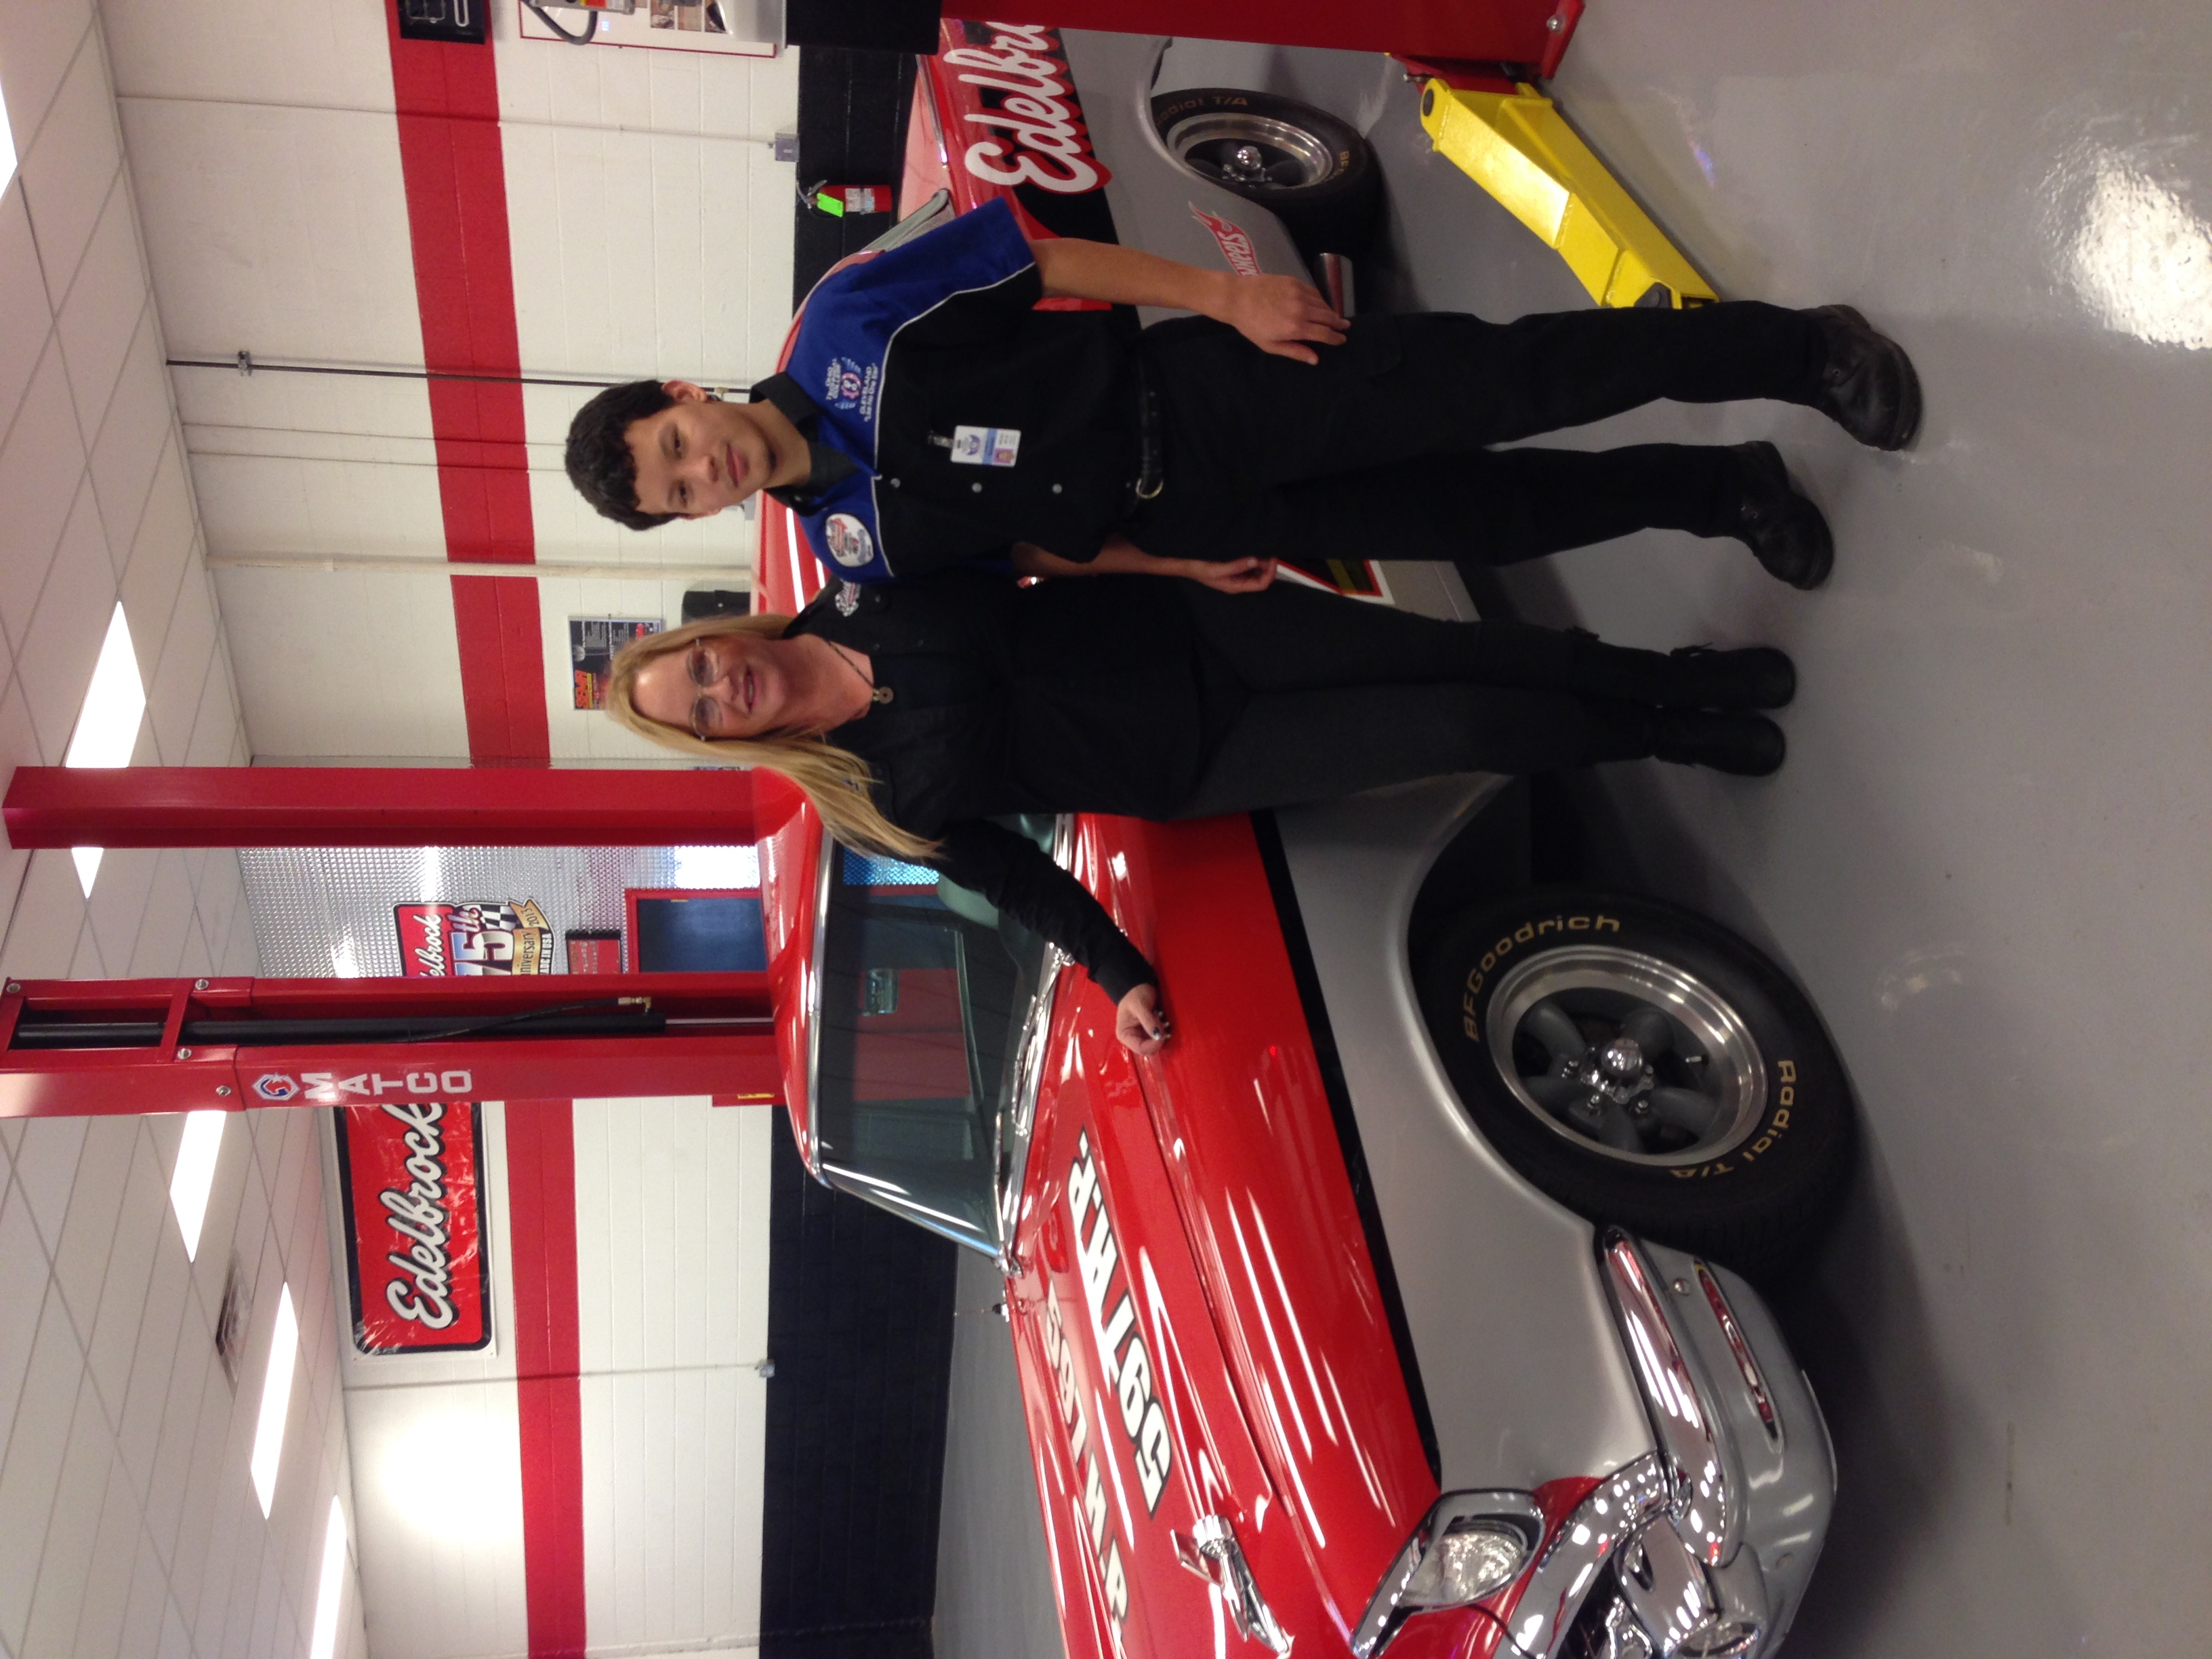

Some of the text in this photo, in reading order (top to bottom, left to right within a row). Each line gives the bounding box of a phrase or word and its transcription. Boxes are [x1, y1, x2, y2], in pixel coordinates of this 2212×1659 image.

[574, 670, 588, 709] SEMA
[413, 914, 445, 976] elbrock
[517, 907, 539, 975] niversary 2013
[539, 933, 552, 975] ADE IN USA
[1463, 914, 1621, 1042] BFGoodrich
[300, 1070, 472, 1102] MATCO
[1671, 1059, 1798, 1180] Radial T/A
[377, 1102, 454, 1329] Edelbrock
[1067, 1129, 1170, 1519] 597 H.P.
[1046, 1279, 1086, 1464] 597
